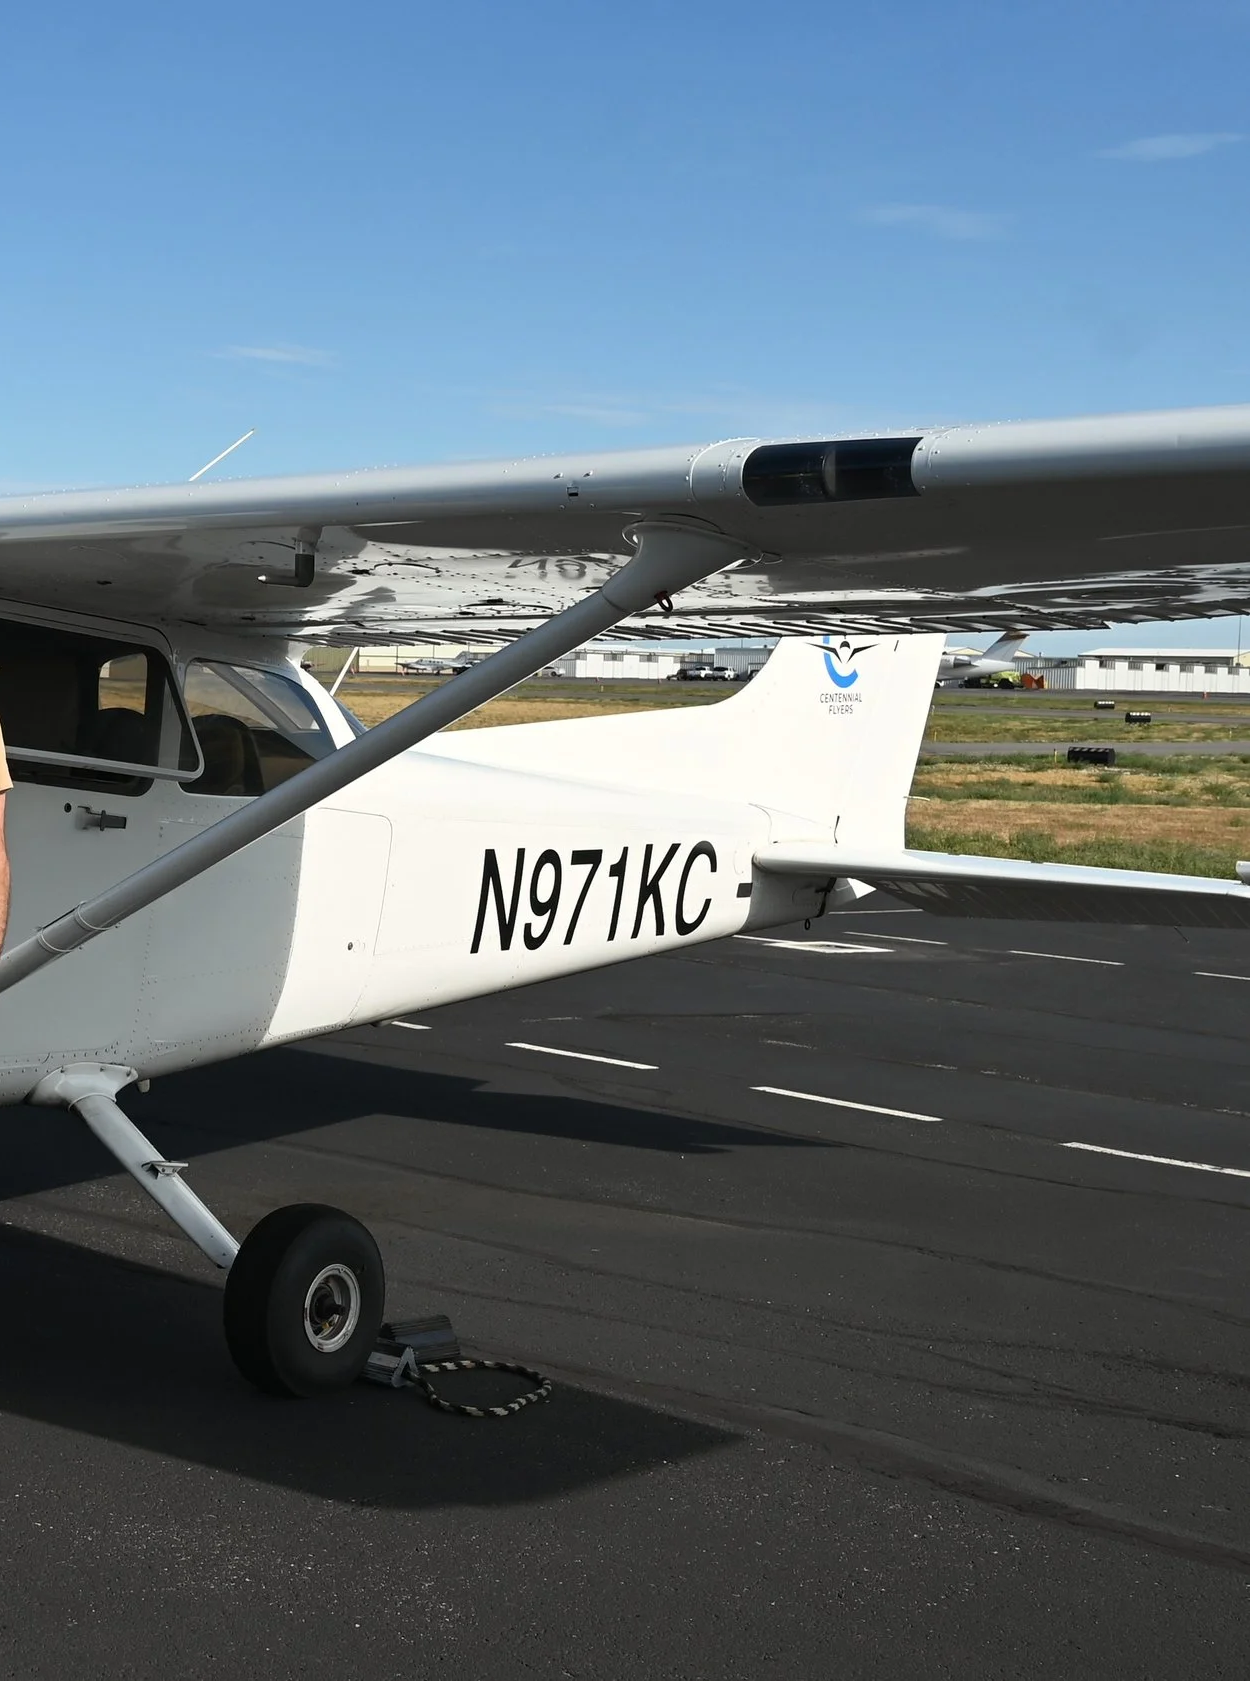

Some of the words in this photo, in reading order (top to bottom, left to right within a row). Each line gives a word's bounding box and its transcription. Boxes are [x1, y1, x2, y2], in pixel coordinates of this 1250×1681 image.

[819, 692, 862, 703] CENTENNIAL
[829, 704, 853, 714] FLYERS
[470, 840, 717, 954] N971KC
